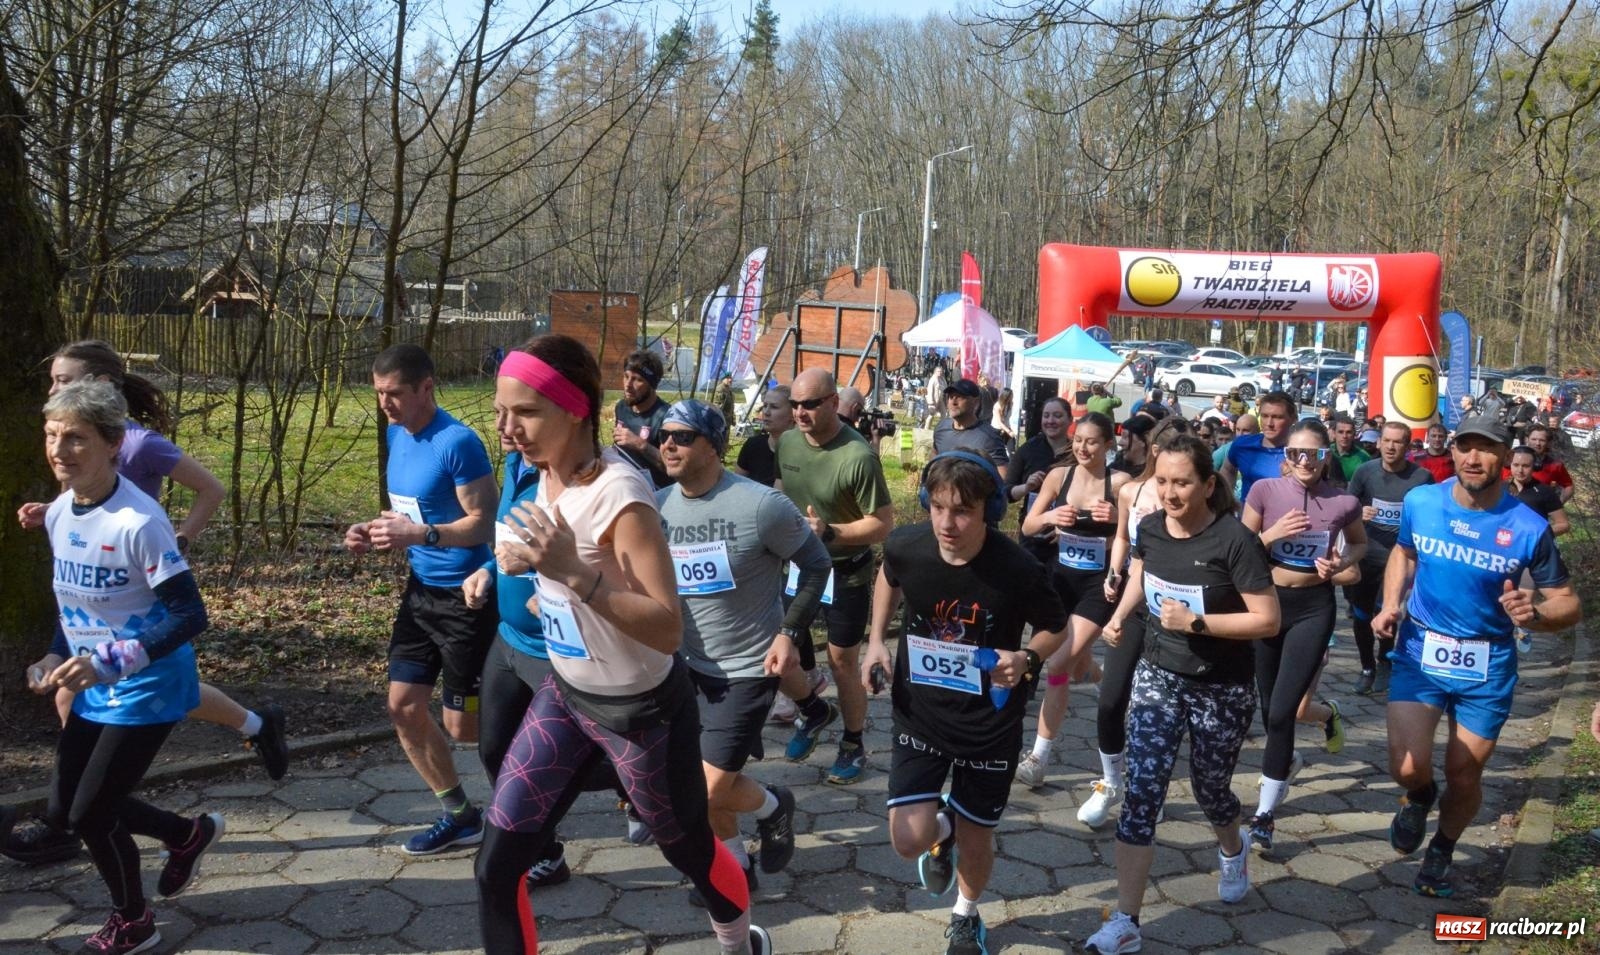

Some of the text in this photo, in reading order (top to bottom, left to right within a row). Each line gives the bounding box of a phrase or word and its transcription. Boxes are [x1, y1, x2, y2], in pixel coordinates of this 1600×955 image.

[1229, 260, 1272, 271] BIEG
[1193, 277, 1311, 292] TWARDZIELA
[1202, 296, 1297, 311] RACIBÓRZ
[1512, 381, 1540, 391] VAMOS
[1067, 546, 1096, 561] 075
[1282, 542, 1318, 558] 027
[1412, 533, 1520, 574] RUNNERS
[681, 561, 718, 582] 069
[1435, 647, 1476, 668] 036
[922, 654, 967, 679] 052
